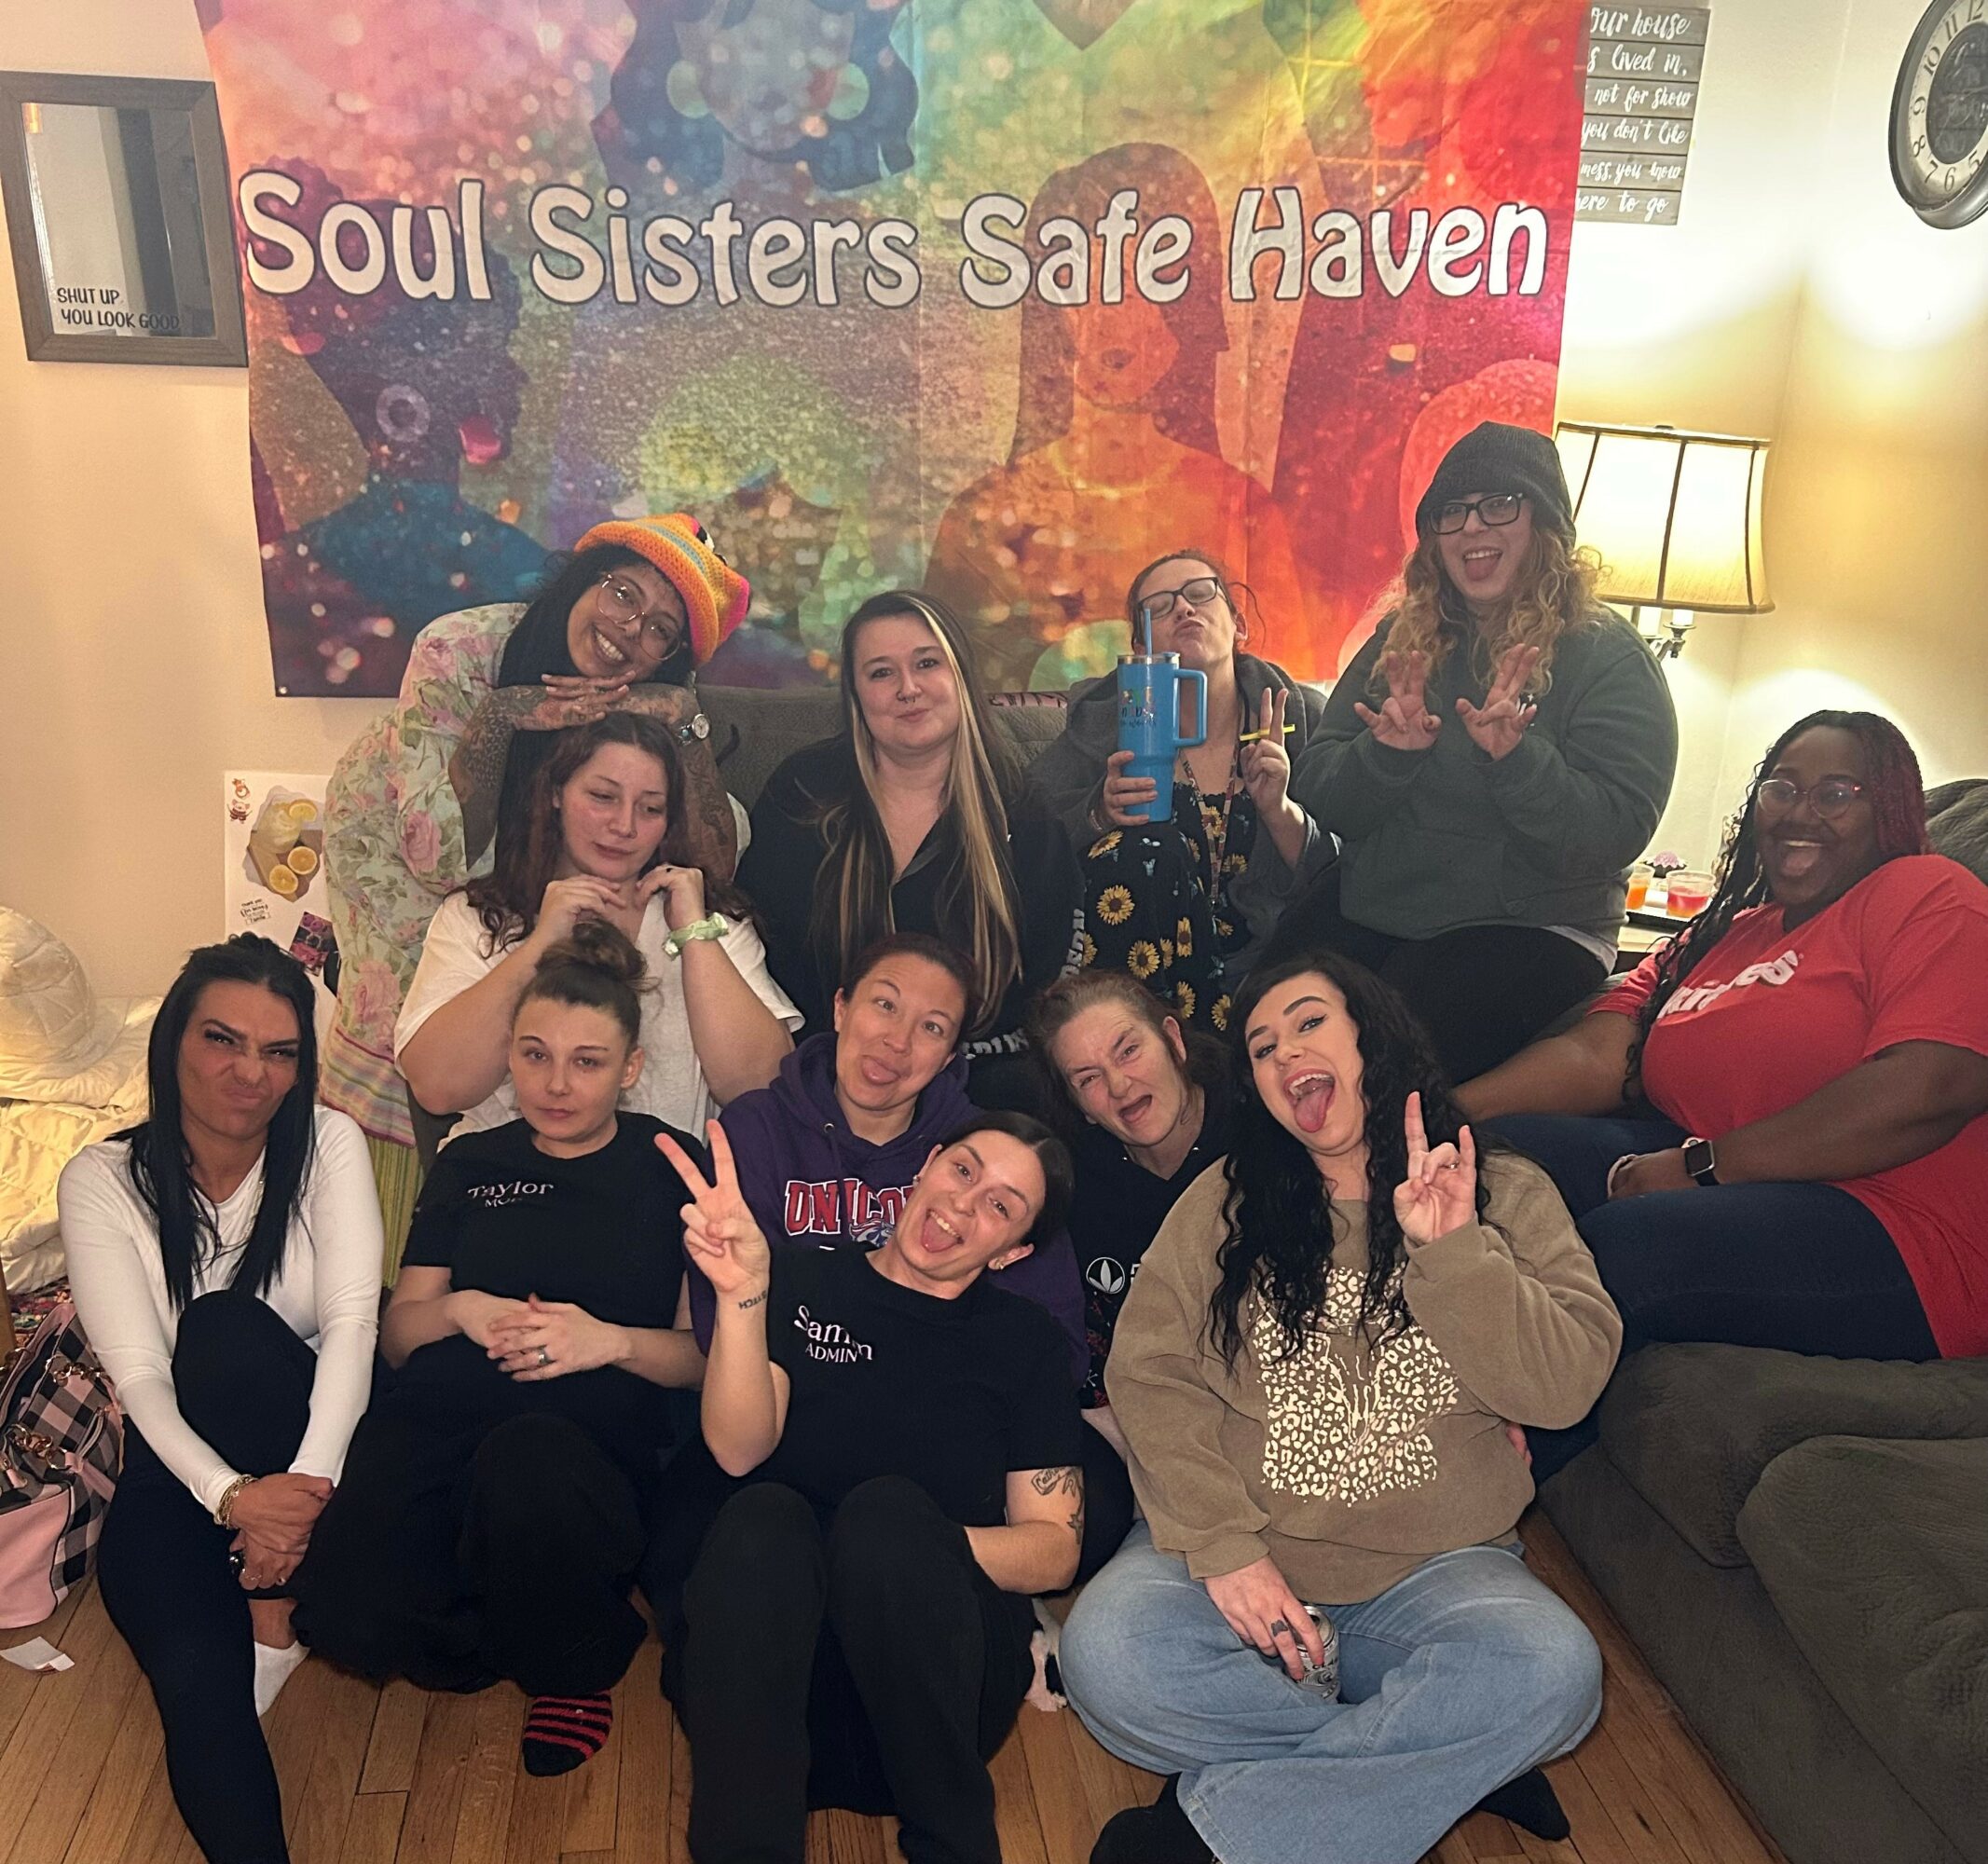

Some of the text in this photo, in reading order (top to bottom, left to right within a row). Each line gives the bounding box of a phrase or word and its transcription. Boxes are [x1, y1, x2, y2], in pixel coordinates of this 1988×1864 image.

[1632, 8, 1691, 40] house
[1945, 13, 1958, 41] 11
[1611, 44, 1656, 71] lived
[1664, 53, 1687, 76] in,
[1924, 46, 1940, 75] 10
[1595, 83, 1693, 112] not for show
[1913, 96, 1926, 116] 9
[1581, 118, 1689, 148] you don't like
[1913, 134, 1926, 158] 8
[1614, 162, 1642, 185] you
[1650, 161, 1682, 181] know
[1925, 160, 1939, 184] 7
[1943, 166, 1956, 192] 6
[1618, 190, 1639, 212] to
[1644, 197, 1669, 222] go
[239, 169, 1550, 310] Soul Sisters Safe Haven
[57, 287, 119, 305] SHUT UP
[61, 308, 180, 330] YOU LOOK GOOD
[467, 1180, 555, 1199] Taylor
[805, 1342, 857, 1363] ADMIN
